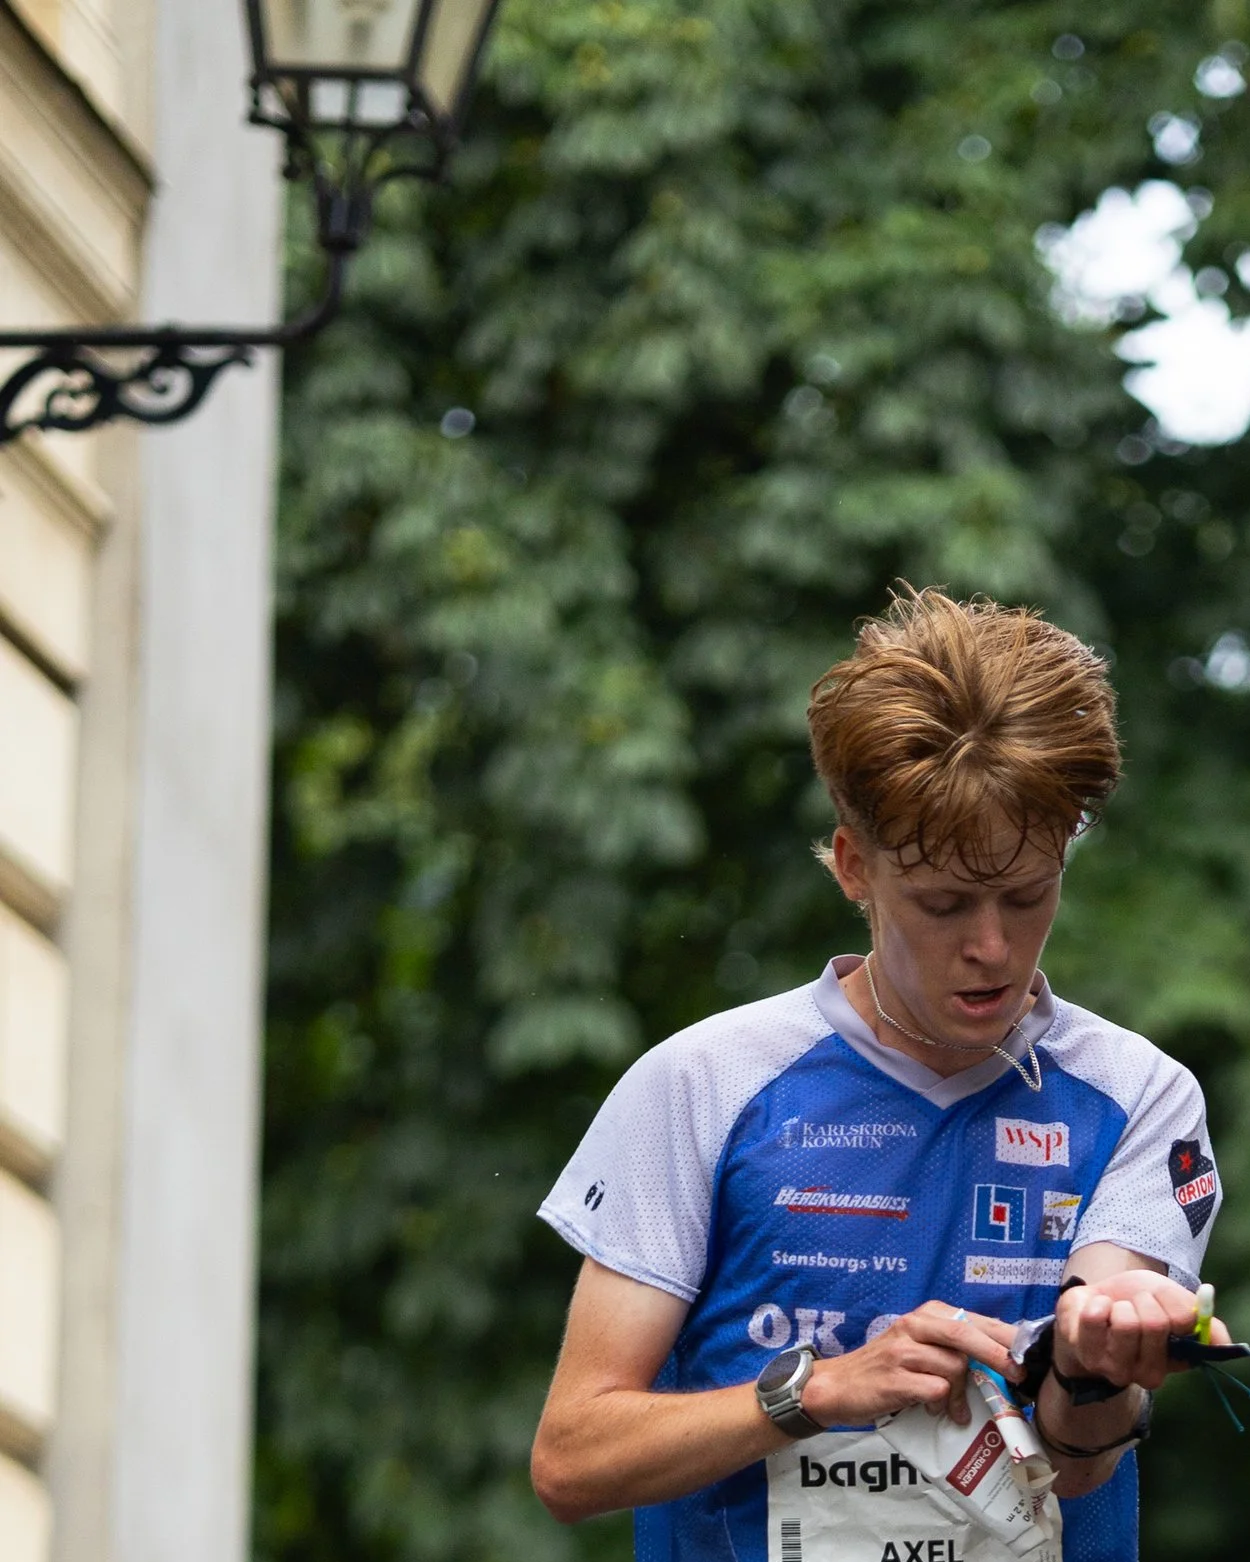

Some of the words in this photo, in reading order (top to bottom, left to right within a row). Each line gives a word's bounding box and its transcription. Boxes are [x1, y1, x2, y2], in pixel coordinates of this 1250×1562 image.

[802, 1136, 883, 1148] KOMMUN
[803, 1123, 918, 1137] KARLSKRONA
[1178, 1172, 1215, 1205] ORION
[1042, 1215, 1072, 1240] EY
[772, 1251, 868, 1272] Stensborgs
[873, 1256, 908, 1271] VVS
[748, 1303, 845, 1356] OK
[800, 1453, 932, 1492] bagh
